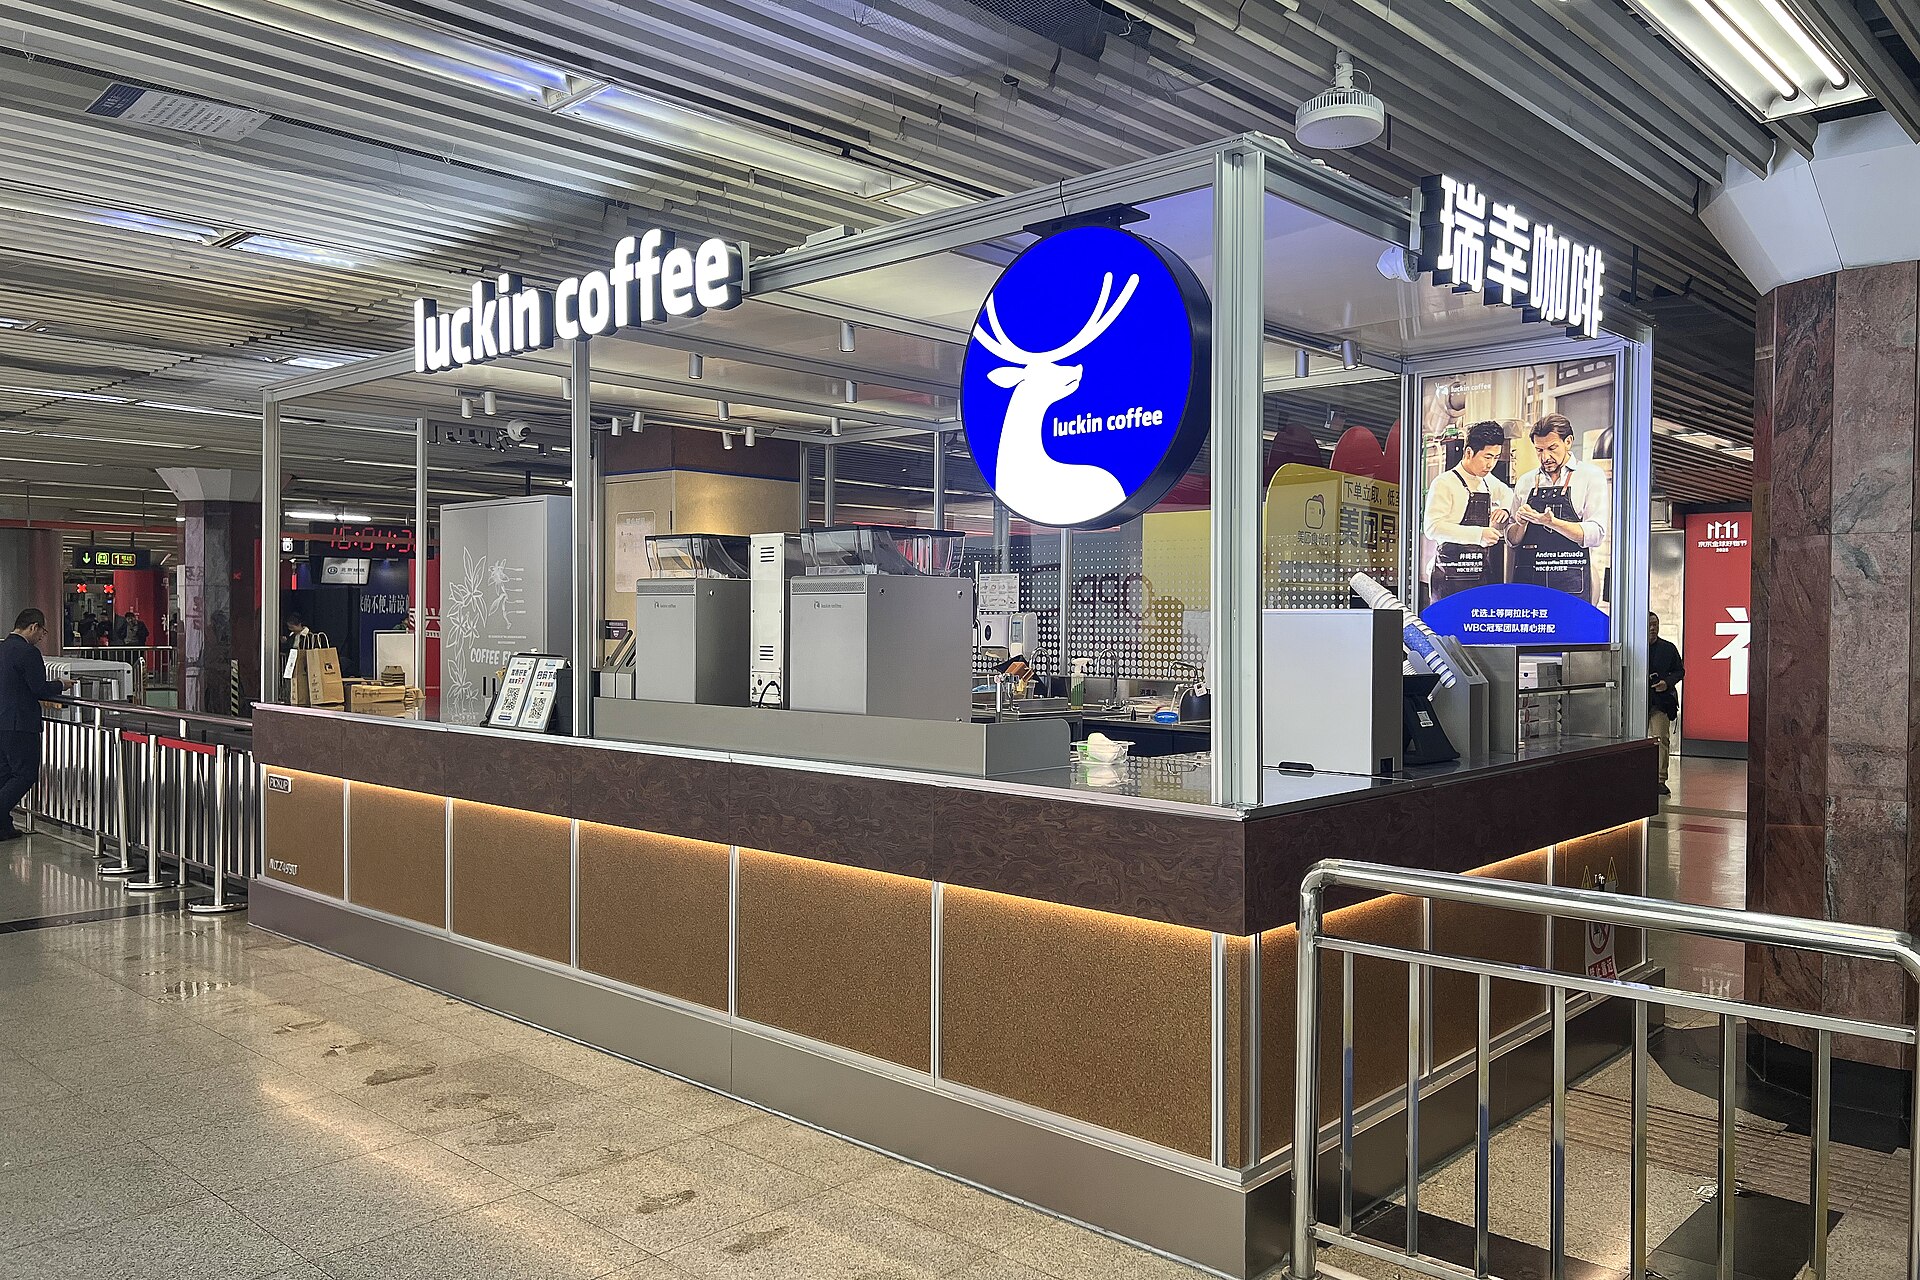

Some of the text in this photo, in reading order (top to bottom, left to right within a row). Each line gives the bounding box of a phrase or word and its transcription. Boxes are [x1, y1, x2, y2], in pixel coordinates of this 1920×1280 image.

[1437, 174, 1605, 339] 瑞幸咖啡
[414, 229, 729, 374] luckin coffee
[1052, 407, 1163, 438] luckin coffee
[1557, 550, 1584, 558] Lattuada
[1471, 608, 1548, 619] 优选上等阿拉比卡豆
[1463, 623, 1556, 634] WBC冠军团队精心拼配
